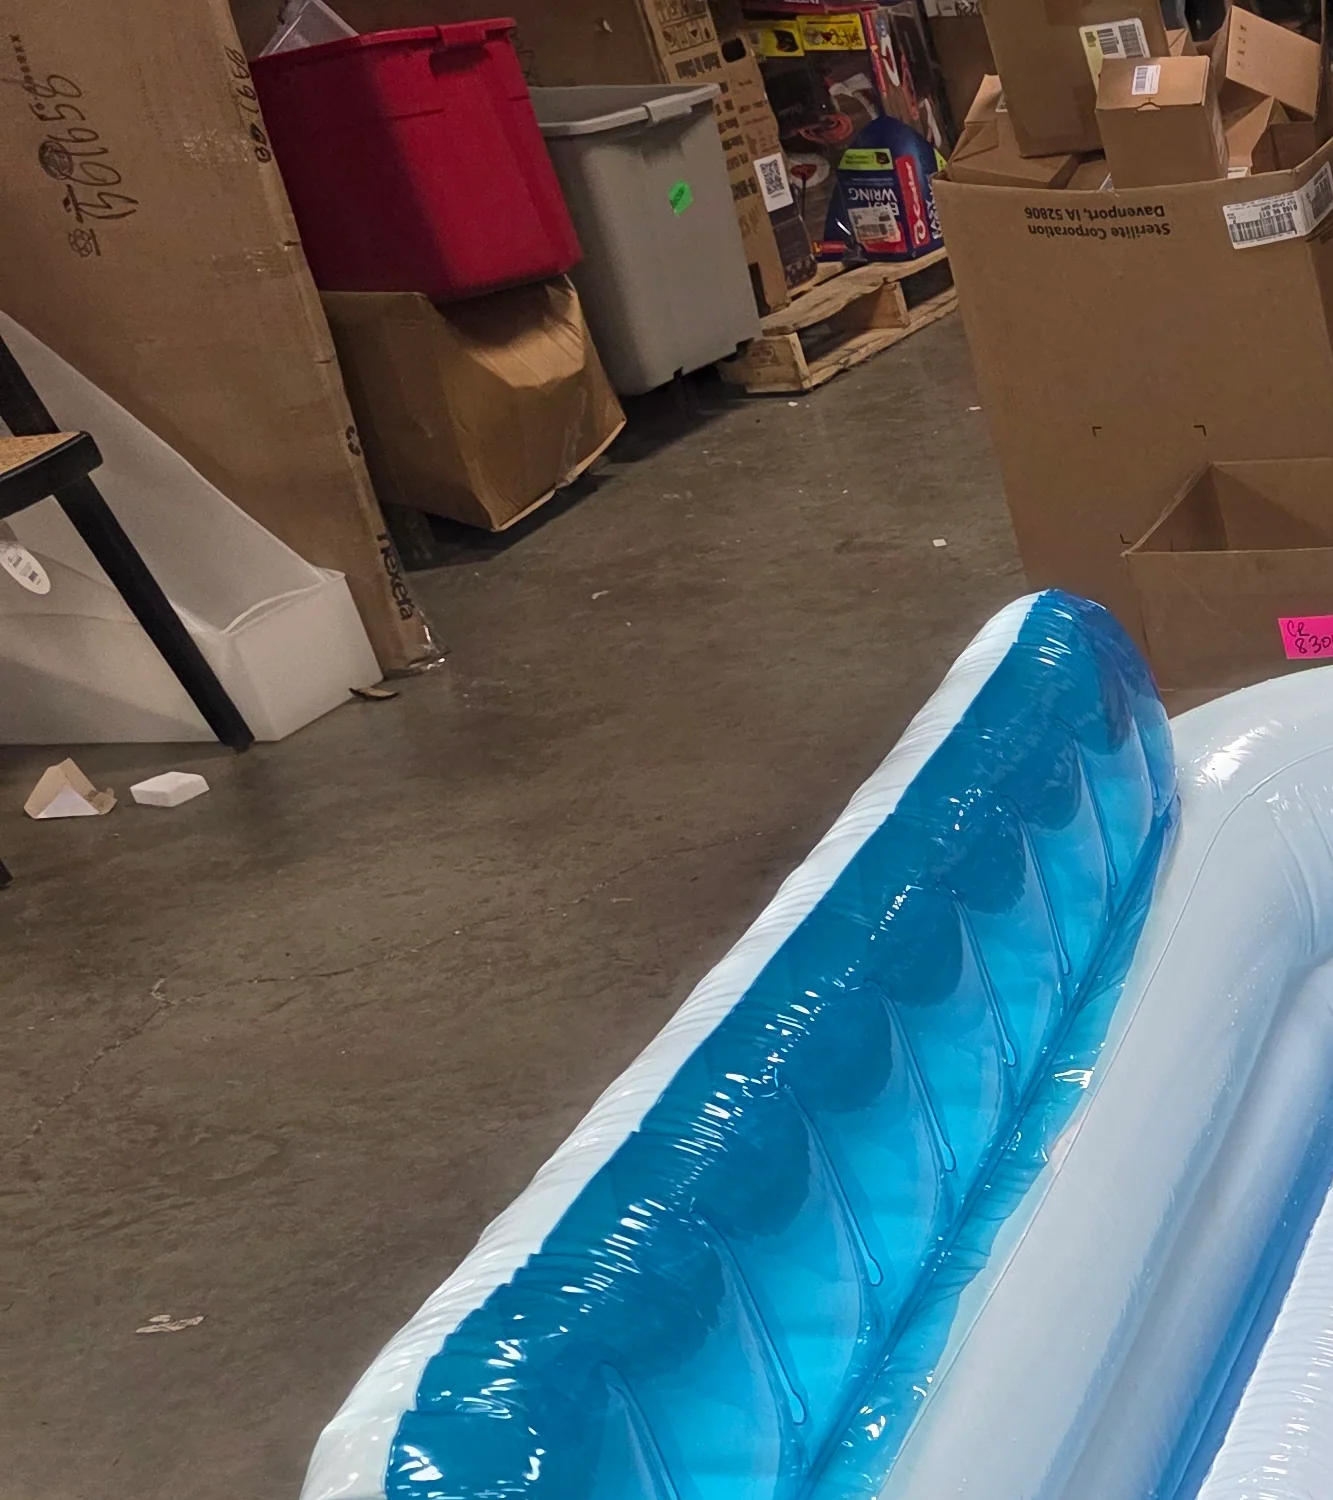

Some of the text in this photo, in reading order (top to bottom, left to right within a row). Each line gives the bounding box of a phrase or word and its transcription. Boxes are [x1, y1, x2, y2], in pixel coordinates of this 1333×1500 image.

[847, 187, 898, 202] WRING
[1024, 205, 1165, 221] Davenport, IA 52806
[1028, 223, 1171, 240] Sterilite Corporation
